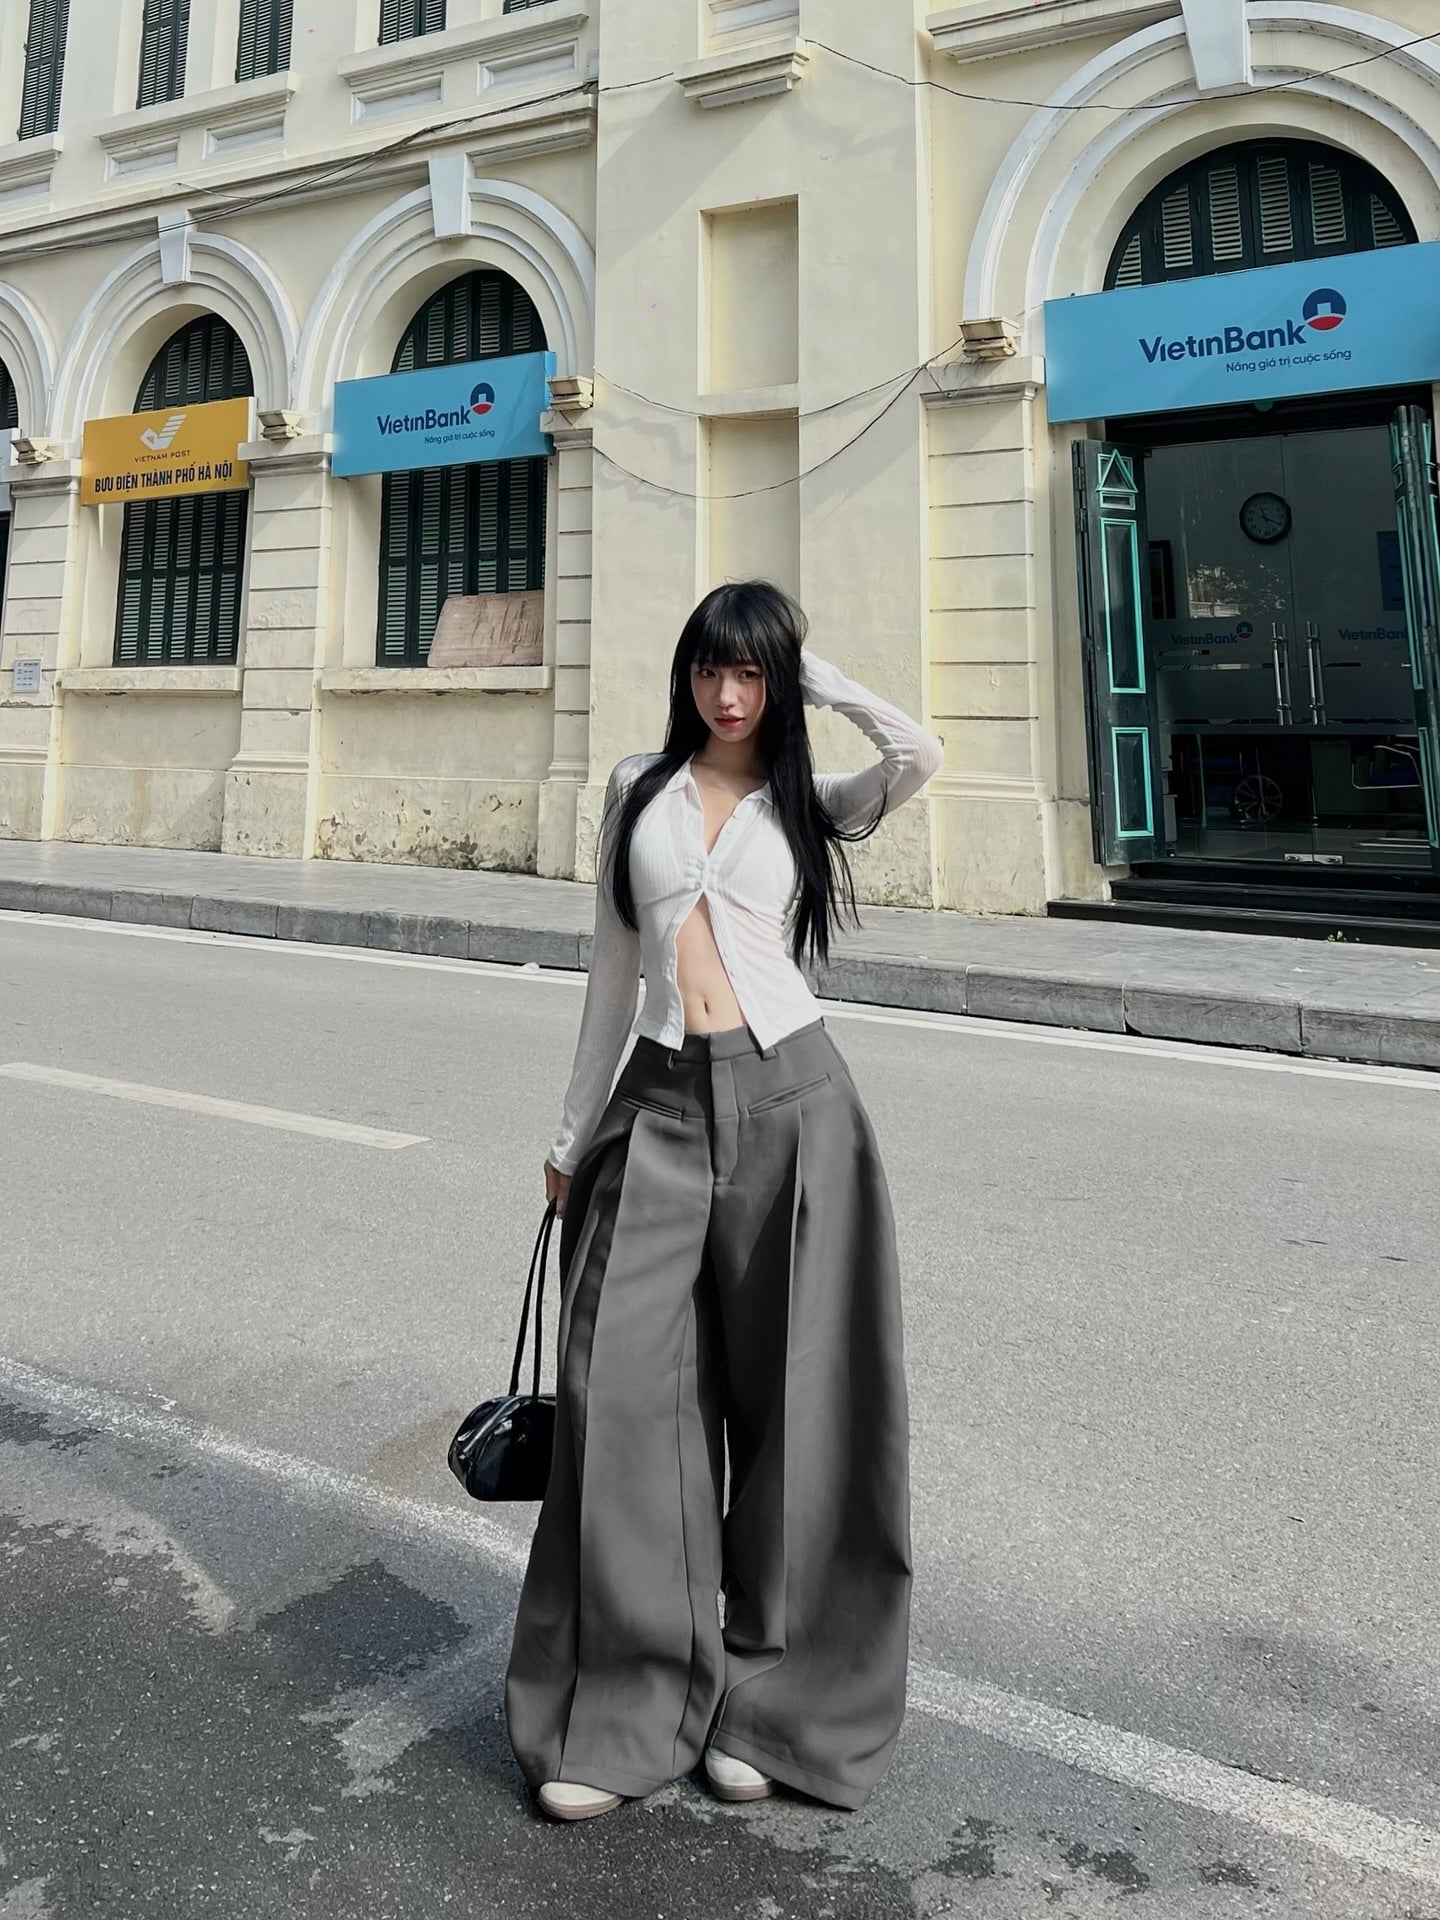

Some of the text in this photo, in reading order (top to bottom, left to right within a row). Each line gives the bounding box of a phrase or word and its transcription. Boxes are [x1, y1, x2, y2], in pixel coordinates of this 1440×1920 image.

[1138, 319, 1308, 363] VietinBank
[1226, 348, 1352, 373] Nâng giá trị cuộc sống
[376, 405, 472, 435] VietinBank
[424, 435, 442, 444] Nâng
[443, 433, 454, 443] giá
[134, 449, 191, 463] VIETNAM POST
[95, 459, 232, 493] BƯU ĐIỆN THÀNH PHỐ HÀ NỘI
[1170, 632, 1238, 645] VietinBank
